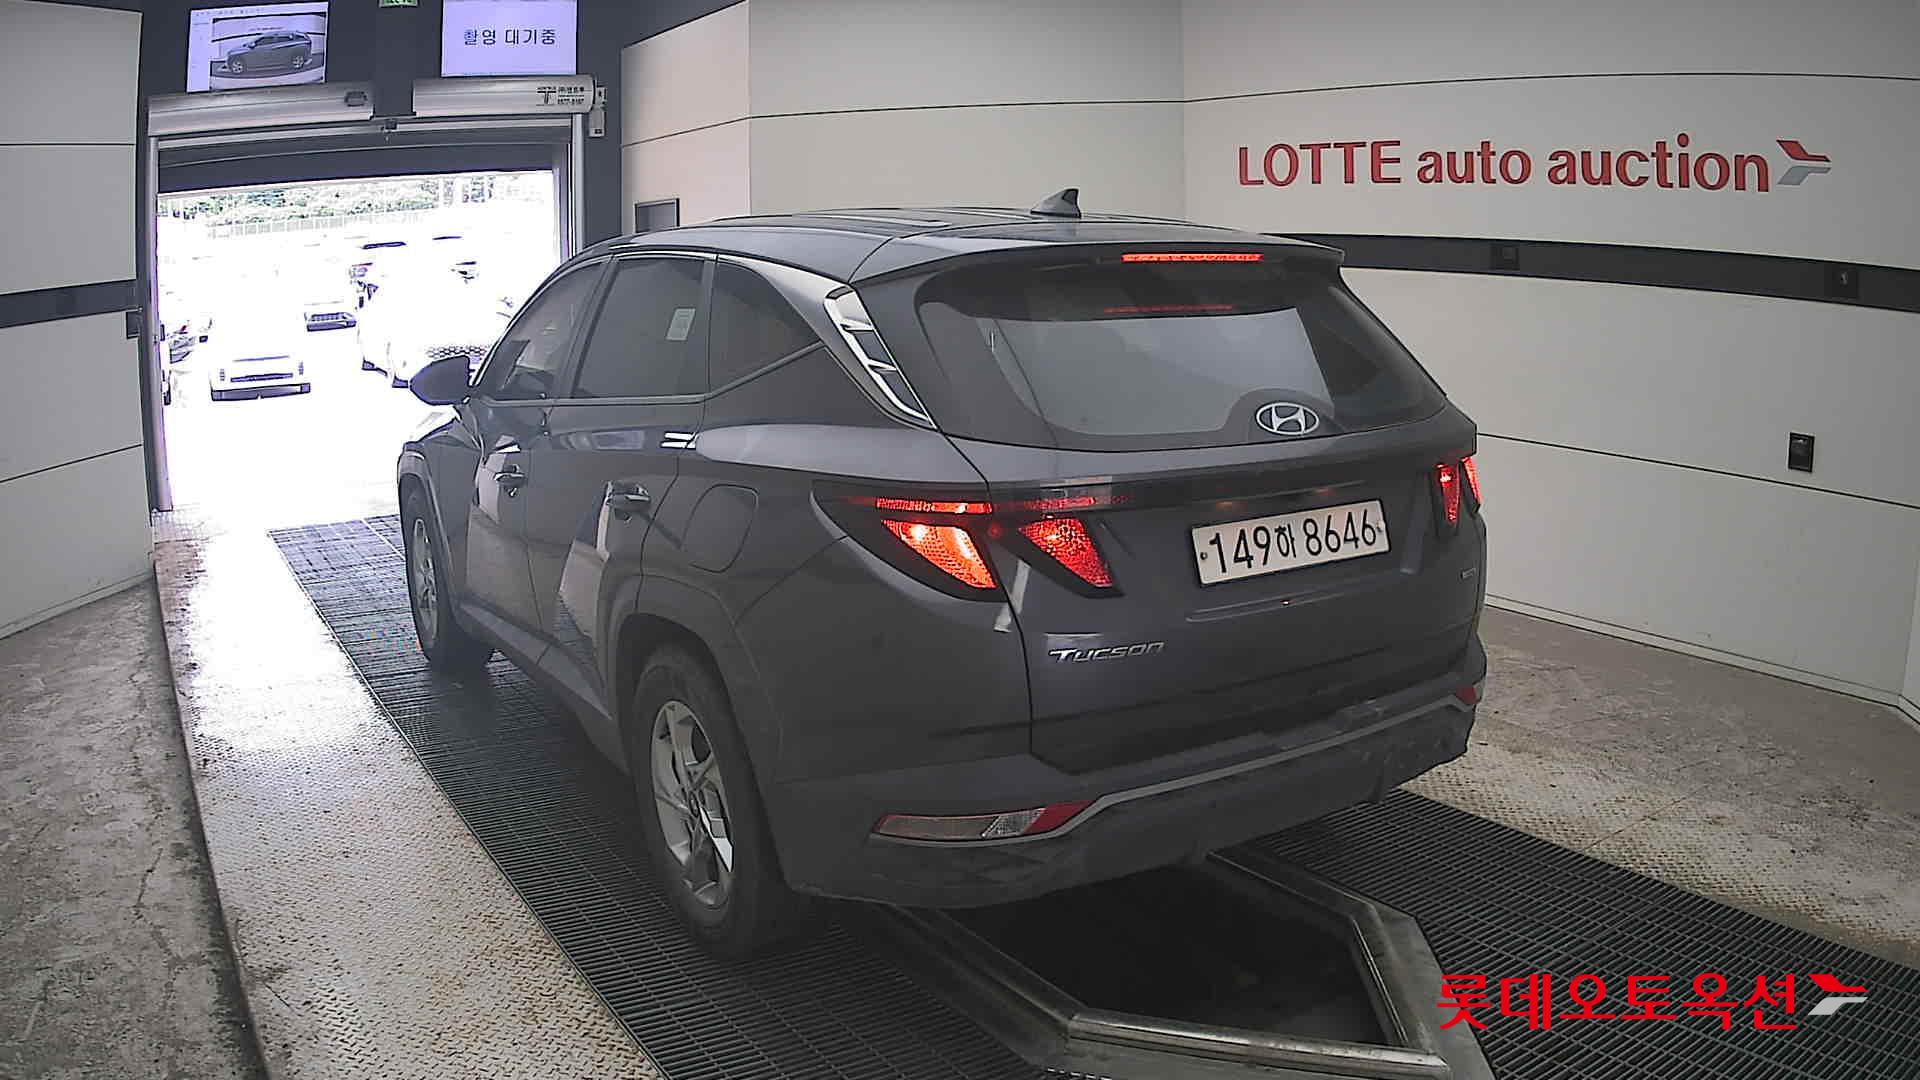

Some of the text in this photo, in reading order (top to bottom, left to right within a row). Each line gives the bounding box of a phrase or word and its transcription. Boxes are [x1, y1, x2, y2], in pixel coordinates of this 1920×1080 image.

[504, 28, 556, 45] 대기중
[1239, 133, 1769, 192] LOTTE auto auction
[1209, 508, 1377, 574] 149하 8646
